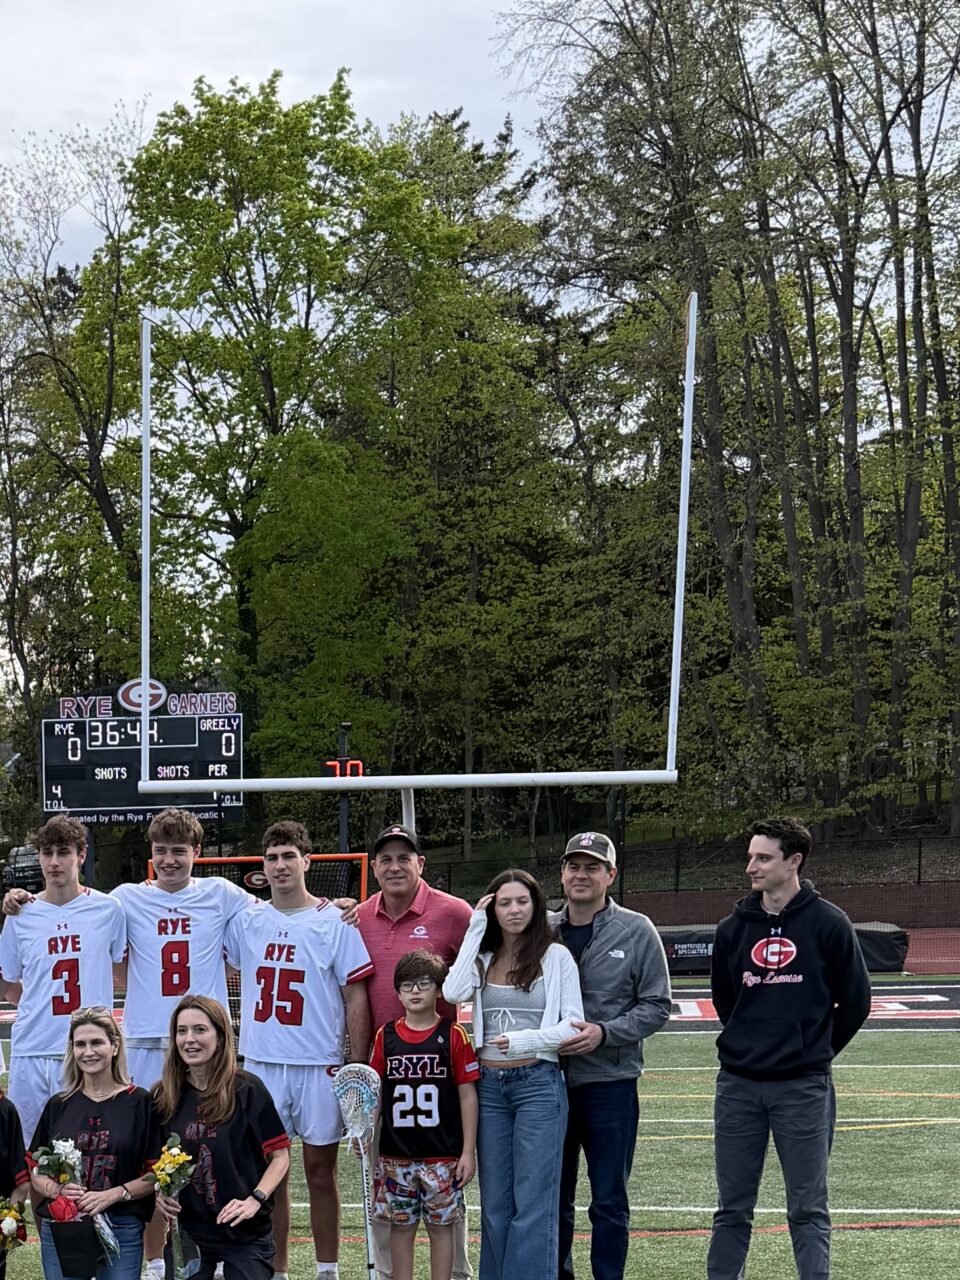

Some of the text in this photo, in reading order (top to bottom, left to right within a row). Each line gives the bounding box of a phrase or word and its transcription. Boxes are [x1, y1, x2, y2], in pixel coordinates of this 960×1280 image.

[60, 696, 113, 718] RYE
[167, 692, 237, 715] GARNETS
[54, 723, 75, 736] RYE
[200, 718, 239, 731] GREELY
[67, 737, 81, 761] 0
[221, 732, 235, 757] 0
[94, 767, 127, 780] SHOTS
[157, 766, 190, 778] SHOTS
[208, 764, 228, 777] PER
[52, 785, 61, 799] 4
[99, 814, 109, 823] by
[112, 813, 124, 822] the
[126, 813, 143, 823] Rye
[157, 917, 191, 935] RYE
[48, 934, 81, 955] RYE
[264, 943, 296, 963] RYE
[161, 940, 191, 997] 8
[52, 958, 81, 1016] 3
[742, 971, 761, 987] Rye
[254, 966, 306, 1027] 35
[387, 1054, 447, 1079] RYL
[392, 1083, 440, 1128] 29
[78, 1130, 110, 1150] RYE
